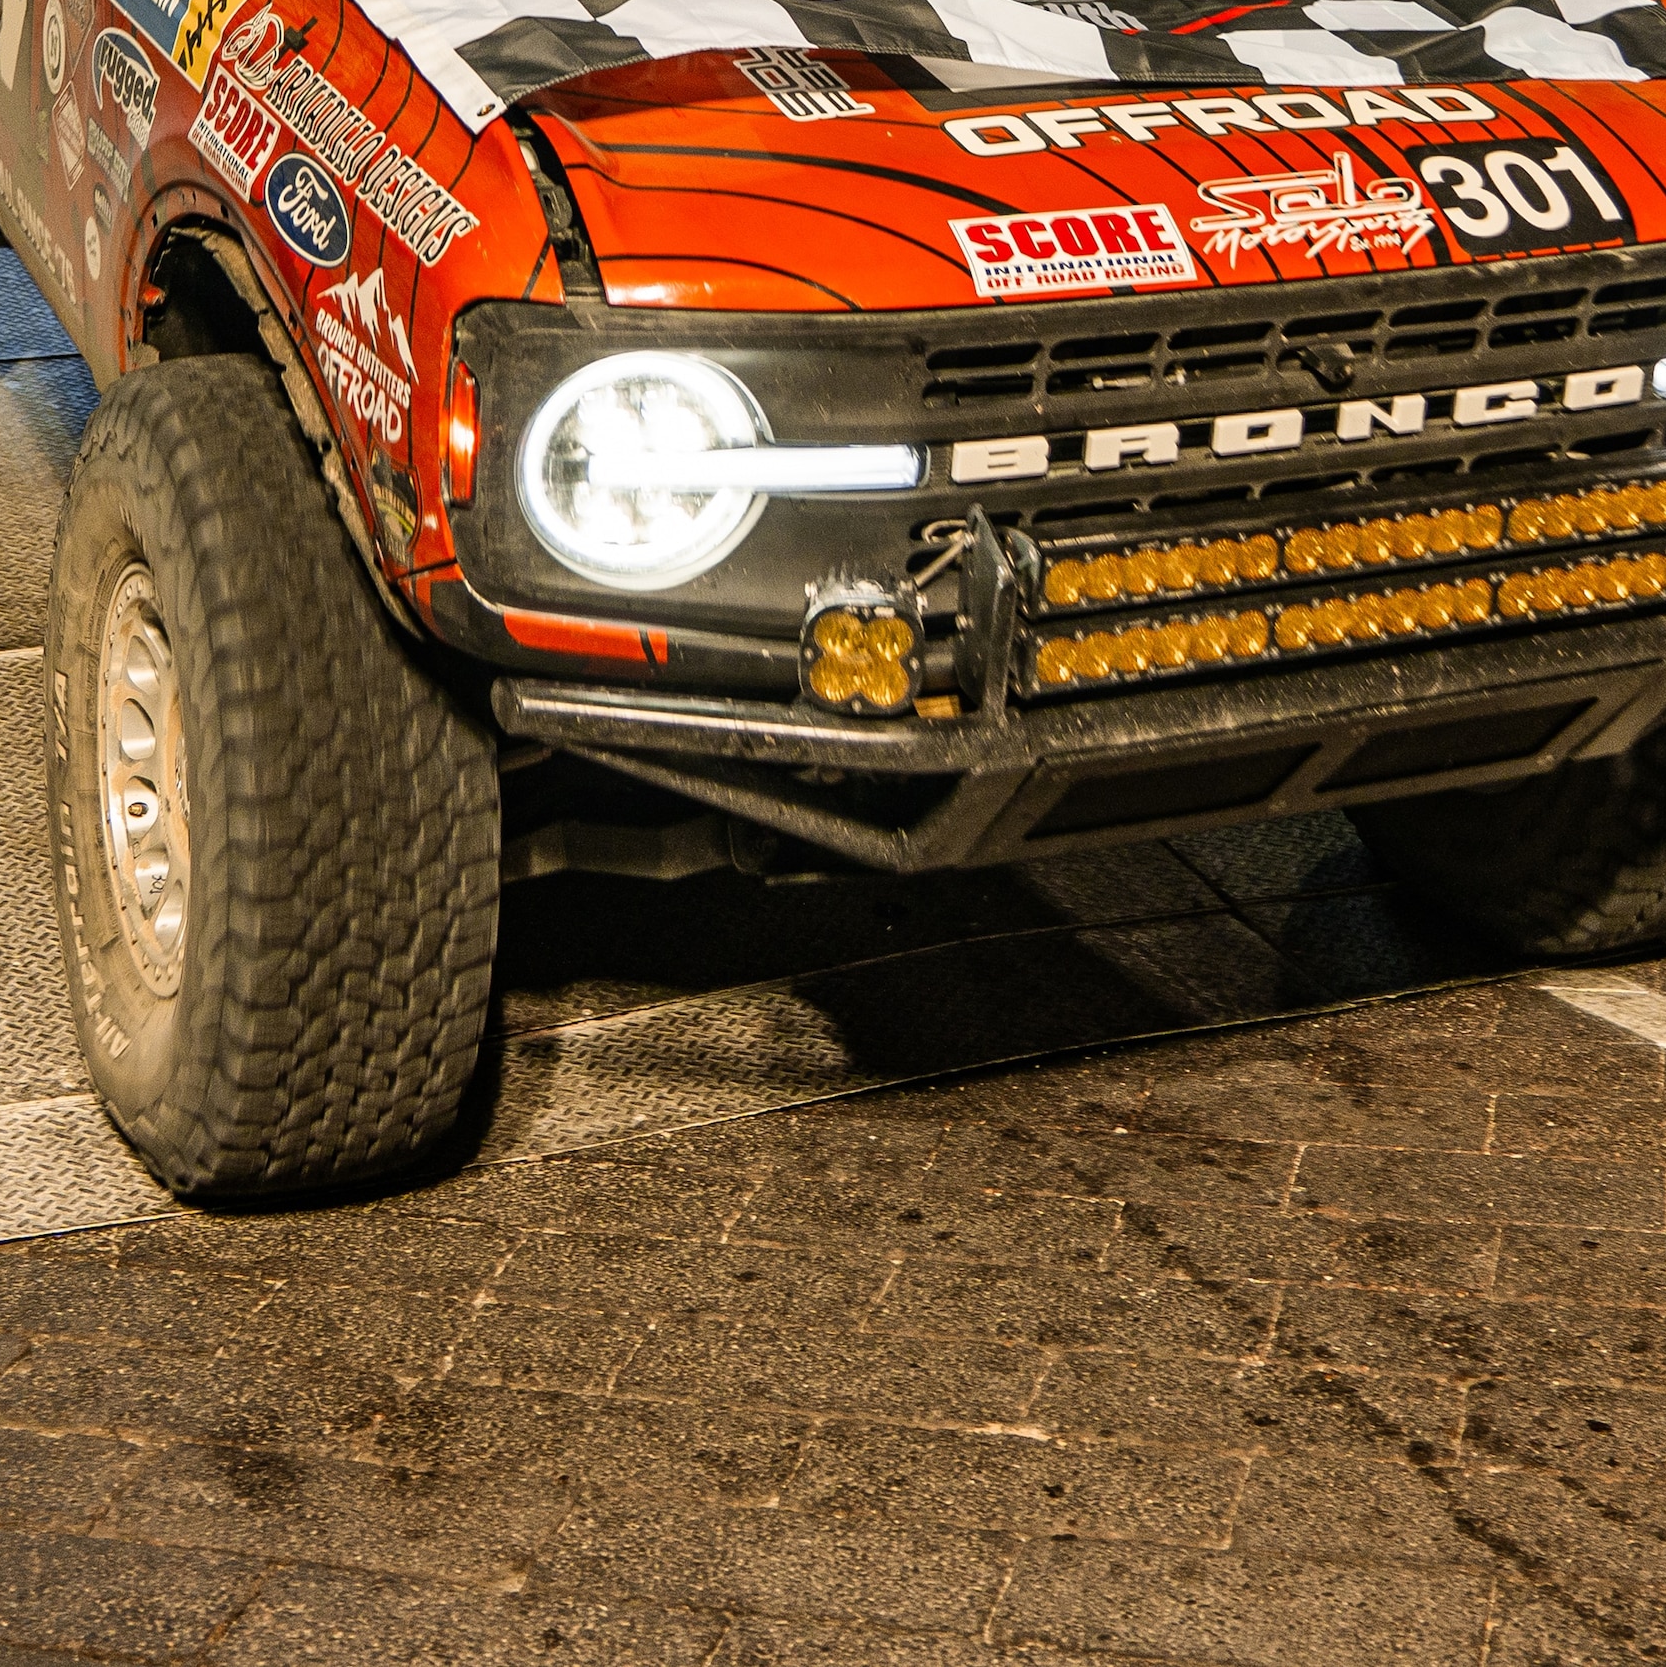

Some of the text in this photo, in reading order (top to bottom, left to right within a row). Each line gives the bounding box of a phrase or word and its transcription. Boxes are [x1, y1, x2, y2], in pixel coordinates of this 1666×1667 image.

[196, 119, 250, 181] INTERNATIONAL
[204, 74, 276, 172] SCORE
[269, 54, 480, 268] ARMADILLO DESIGNS
[939, 85, 1498, 159] OFFROAD
[278, 164, 338, 252] Ford
[965, 209, 1177, 264] SCORE
[1419, 145, 1623, 239] 301
[983, 253, 1181, 276] INTERNATIONAL
[1104, 263, 1186, 282] RACING
[315, 307, 412, 410] BRONCO OUTFITTERS
[317, 342, 403, 444] OFFROAD
[950, 363, 1649, 486] BRONCO
